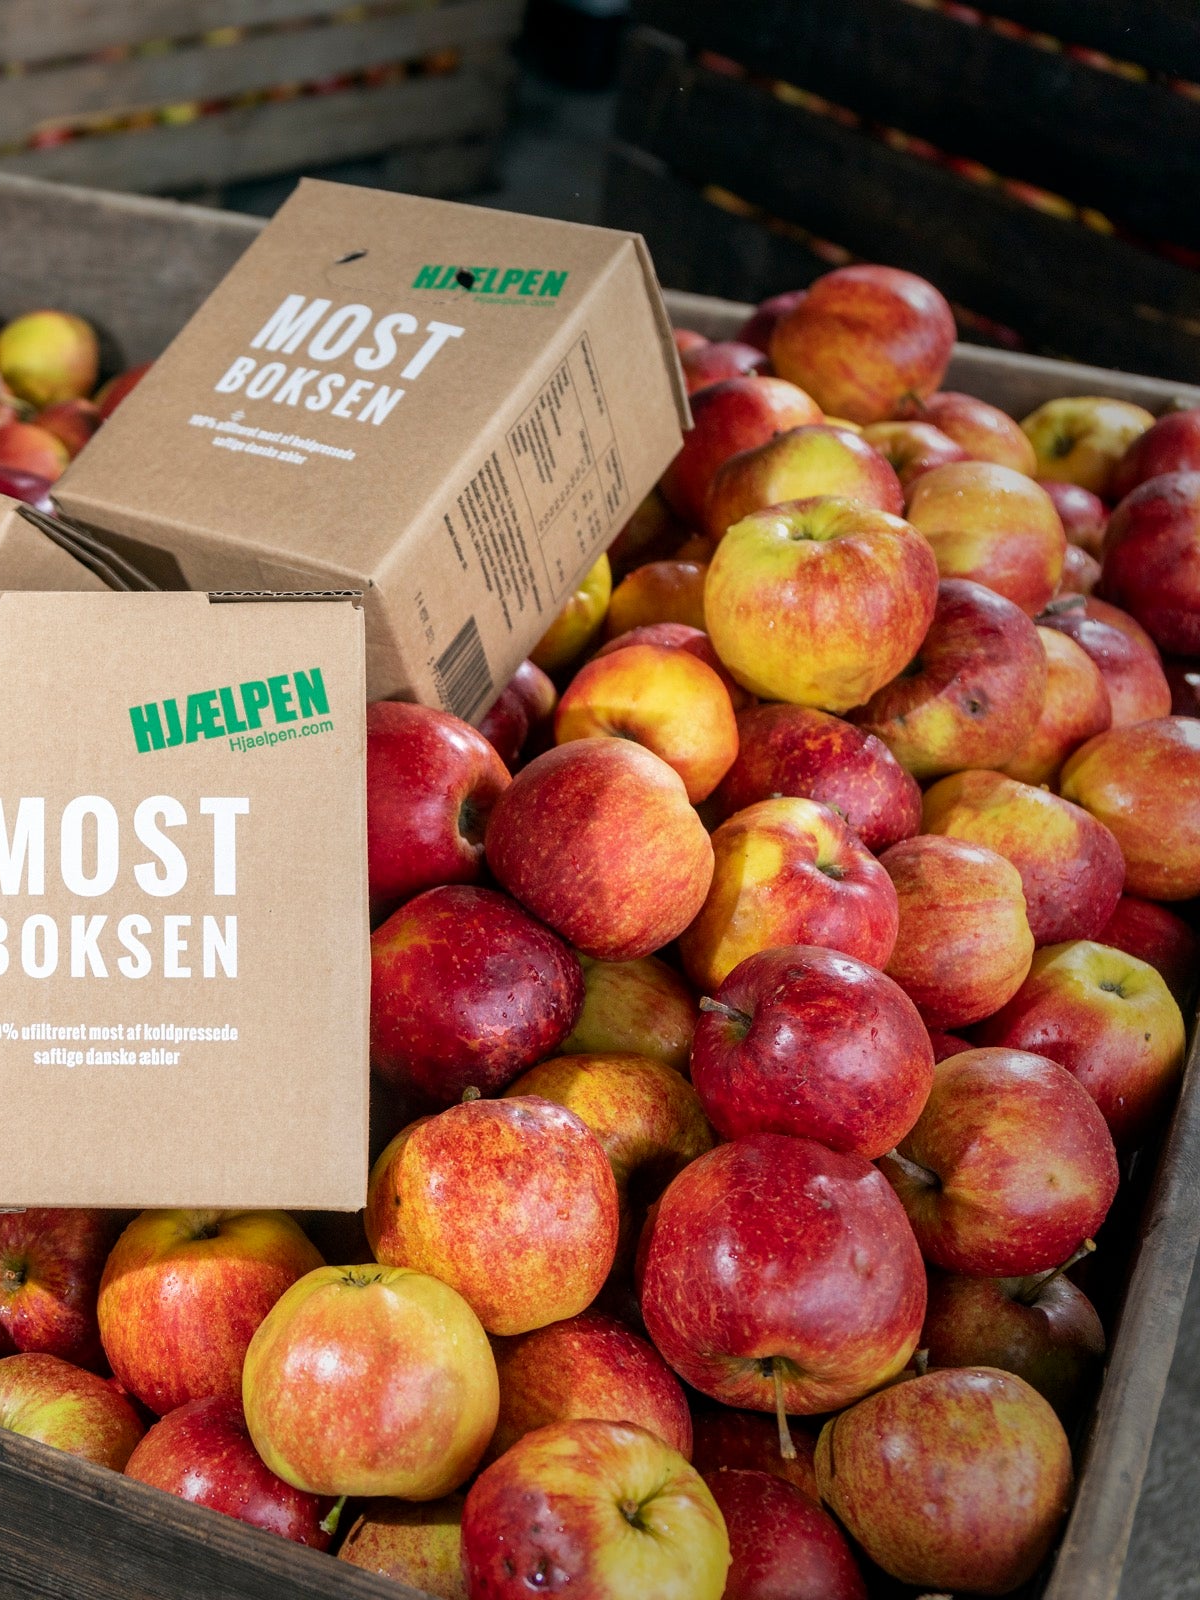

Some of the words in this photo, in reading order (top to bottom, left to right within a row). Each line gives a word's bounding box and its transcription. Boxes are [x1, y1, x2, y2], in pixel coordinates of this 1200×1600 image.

[250, 294, 465, 380] MOST
[214, 356, 405, 425] BOKSEN
[129, 667, 330, 753] HJÆLPEN
[229, 720, 334, 752] Hjaelpen.com
[21, 1023, 86, 1040] ufiltreret
[89, 1024, 124, 1040] most
[126, 1024, 143, 1040] af
[144, 1024, 239, 1044] koldpressede
[33, 1048, 83, 1068] saftige
[86, 1048, 136, 1065] danske
[139, 1048, 180, 1065] æbler
